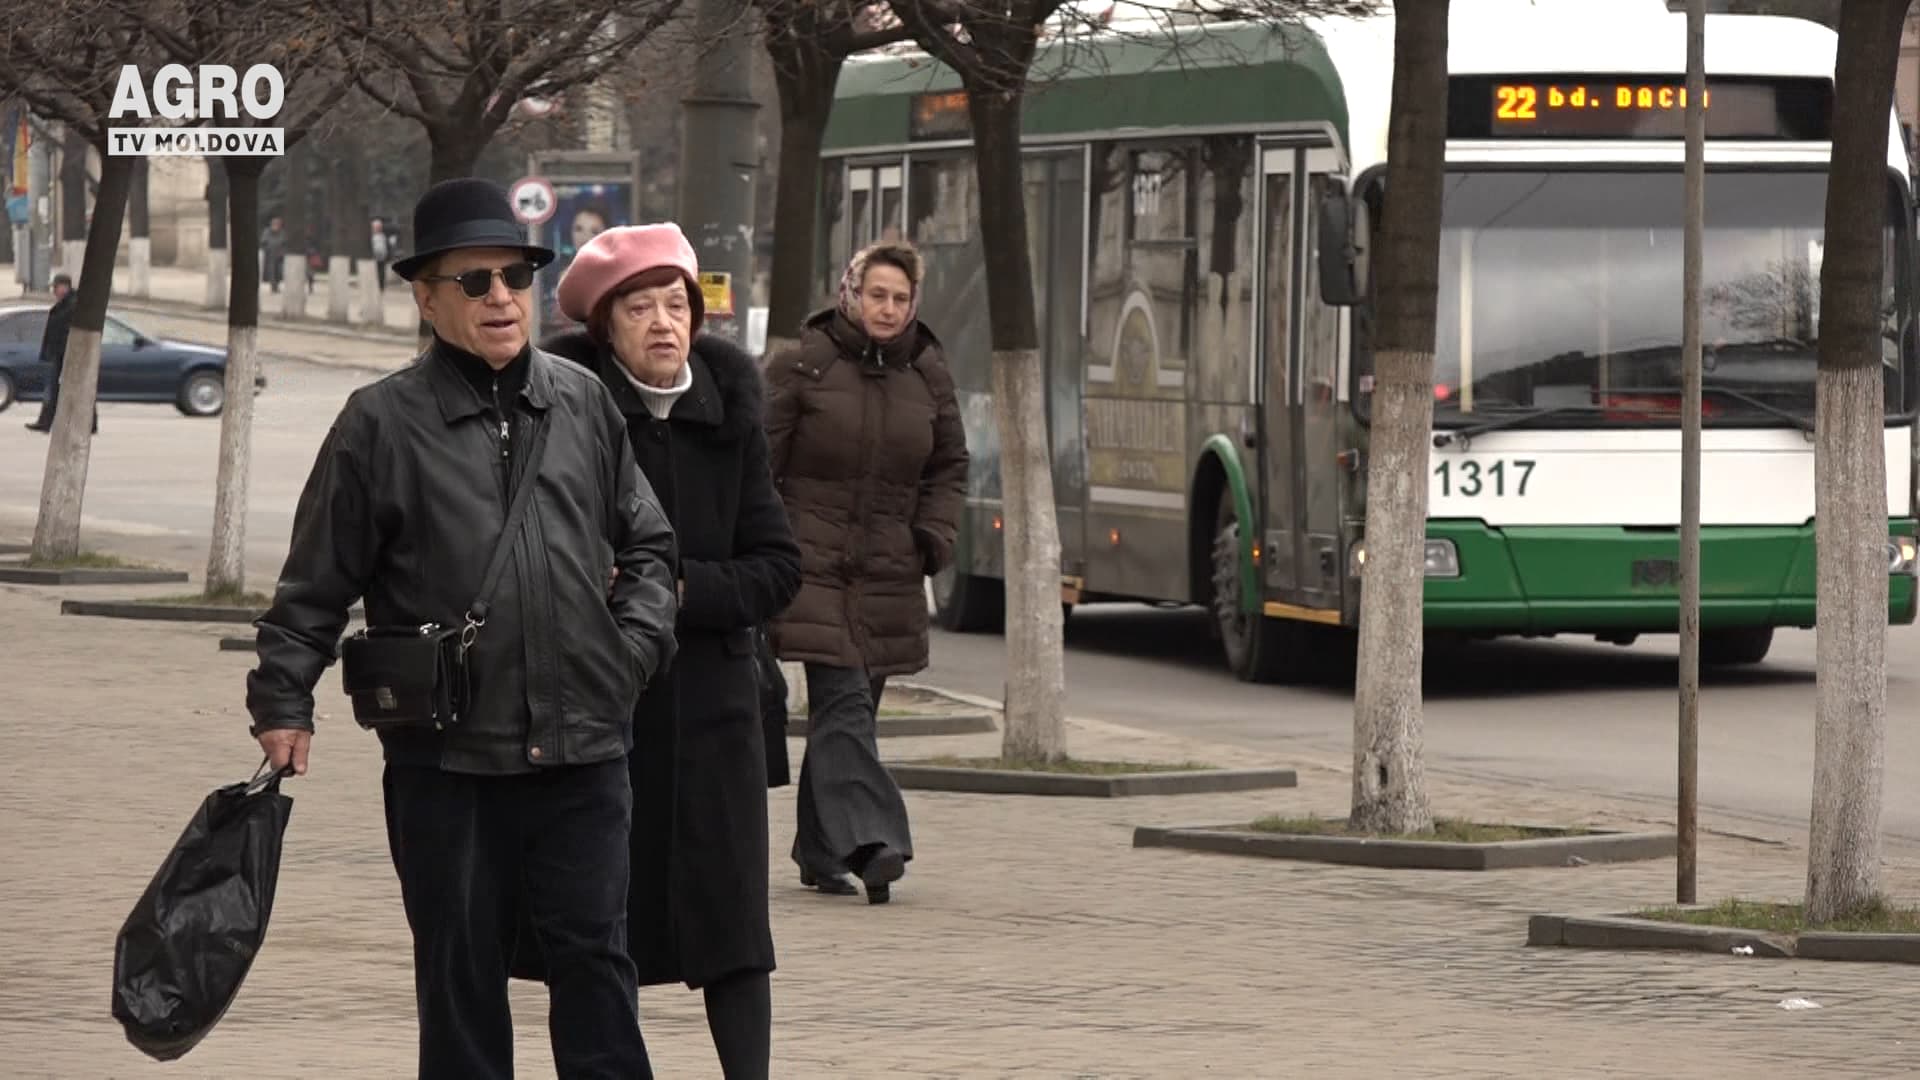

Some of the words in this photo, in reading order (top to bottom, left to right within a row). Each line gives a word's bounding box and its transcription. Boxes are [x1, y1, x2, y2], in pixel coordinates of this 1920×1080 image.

[1497, 86, 1536, 119] 22
[1549, 86, 1599, 107] bd.
[1434, 459, 1536, 497] 1317
